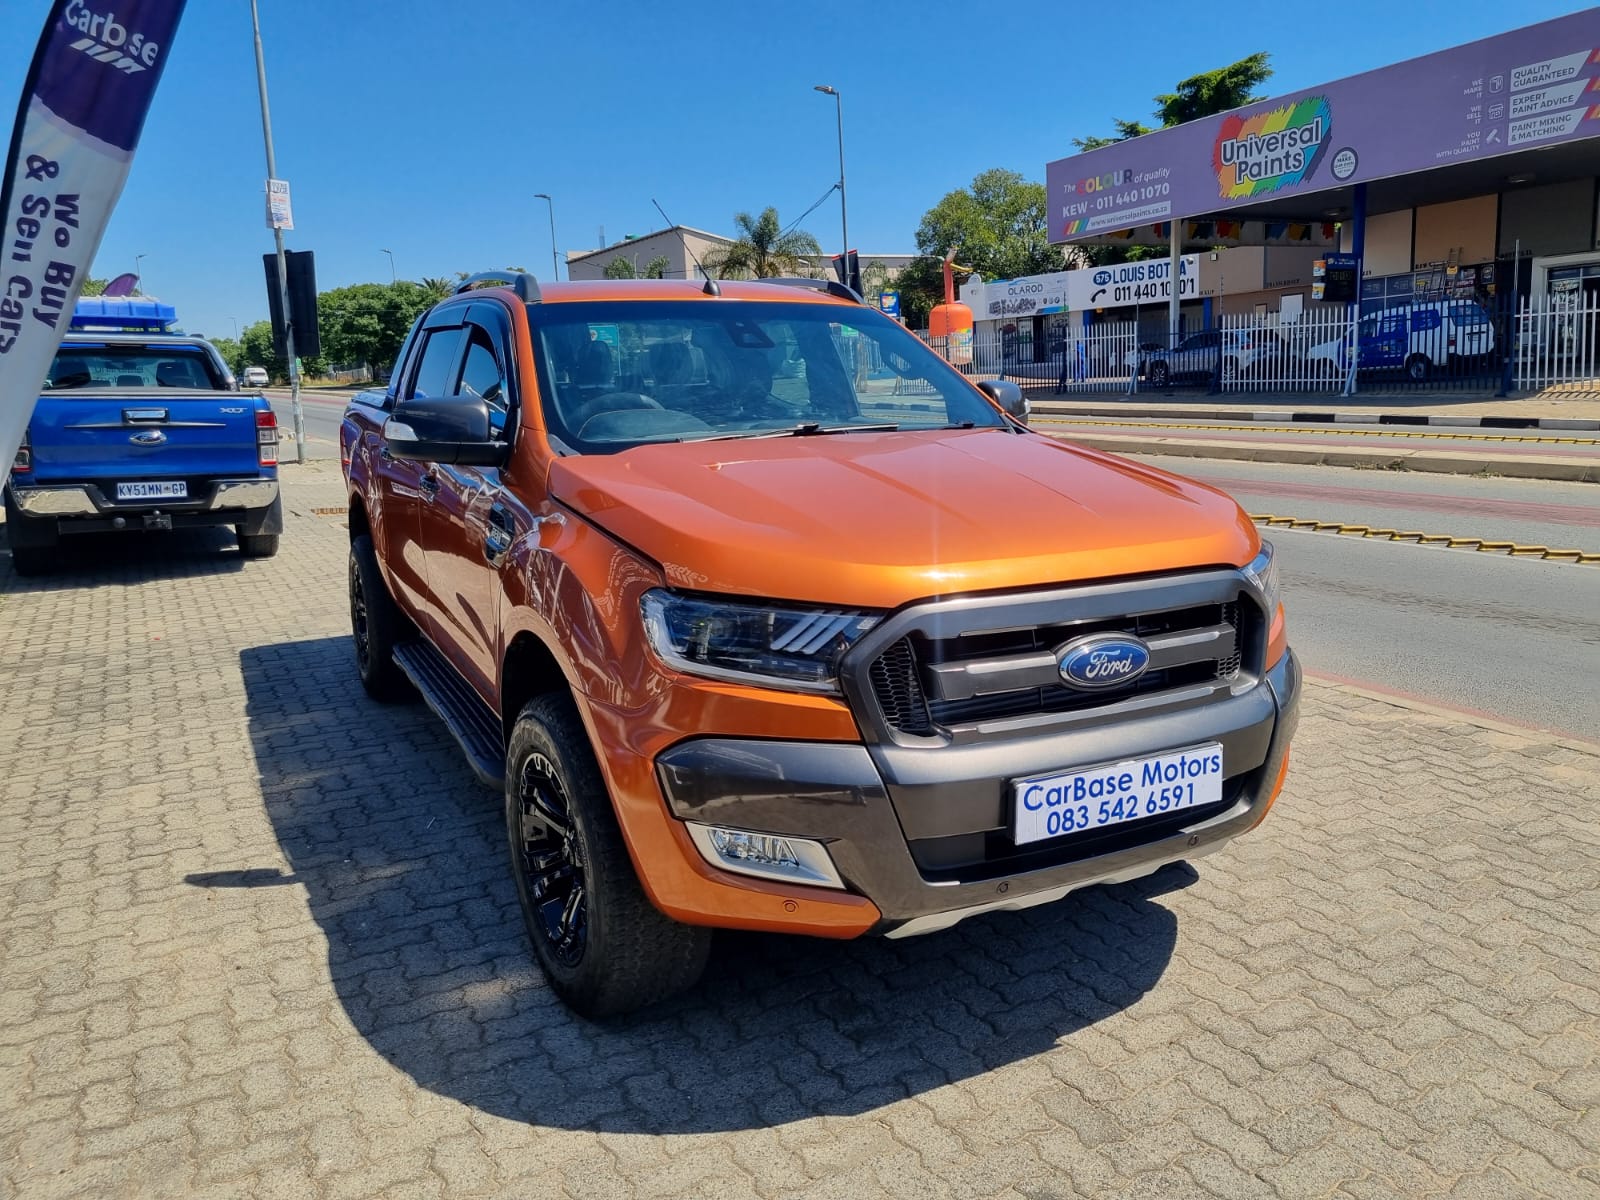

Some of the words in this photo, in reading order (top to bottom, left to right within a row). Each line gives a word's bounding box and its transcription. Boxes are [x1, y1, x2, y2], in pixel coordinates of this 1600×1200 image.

[65, 0, 158, 67] Carbse
[1513, 67, 1575, 87] GUARANTEED
[1514, 64, 1551, 79] QUALITY
[1464, 86, 1482, 95] MAKE
[1513, 92, 1546, 106] EXPERT
[1512, 104, 1538, 115] PAINT
[1540, 94, 1574, 110] ADVICE
[1511, 134, 1517, 142] &
[1518, 125, 1565, 140] MATCHING
[1512, 121, 1537, 133] PAINT
[1539, 114, 1572, 128] MIXING
[1222, 119, 1321, 164] Universal
[1453, 144, 1480, 155] QUALITY
[25, 154, 60, 182] &
[1237, 152, 1302, 182] Paints
[1064, 184, 1076, 194] The
[1077, 169, 1132, 196] COLOUR
[1134, 174, 1142, 184] of
[1144, 168, 1170, 182] quality
[1063, 202, 1088, 218] KEW
[1096, 196, 1113, 210] 011
[1116, 190, 1138, 206] 440
[1141, 182, 1170, 199] 1070
[1096, 274, 1108, 282] 575
[1113, 266, 1144, 284] LOUIS
[1148, 260, 1186, 280] BOTA
[32, 260, 76, 330] Buy
[1114, 286, 1131, 302] 011
[1134, 283, 1156, 299] 440
[118, 483, 162, 496] KY51MN
[172, 482, 186, 494] GP
[1086, 650, 1132, 678] Ford
[1024, 773, 1133, 812] CarBase
[1142, 754, 1220, 788] Motors
[1047, 805, 1090, 834] 083
[1097, 795, 1138, 824] 542
[1146, 783, 1194, 814] 6591
